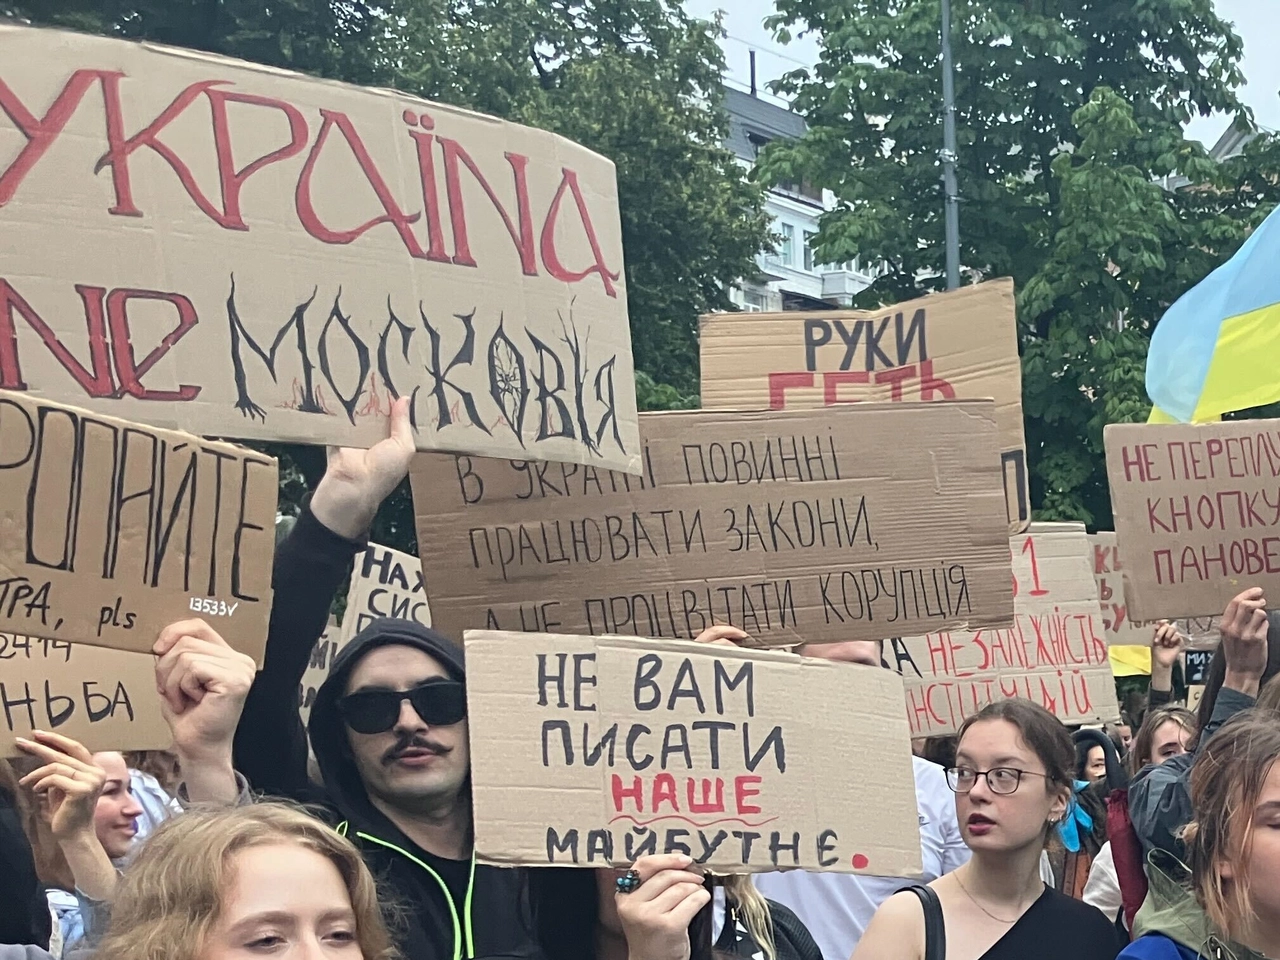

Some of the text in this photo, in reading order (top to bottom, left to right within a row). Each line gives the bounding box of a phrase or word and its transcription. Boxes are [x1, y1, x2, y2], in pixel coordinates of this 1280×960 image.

[227, 271, 628, 458] МОСКОВІЯ
[804, 308, 928, 372] РУКИ
[455, 454, 484, 505] В
[681, 426, 841, 486] ПОВИННІ
[1121, 443, 1162, 483] НЕ
[468, 495, 881, 580] ПРАЦЮВАТИ ЗАКОНИ,
[97, 596, 138, 637] pls
[821, 560, 972, 624] КОРУПЦІЯ
[535, 652, 755, 718] НЕ ВАМ
[541, 719, 787, 774] ПИСАТИ
[611, 772, 763, 815] НАШЕ
